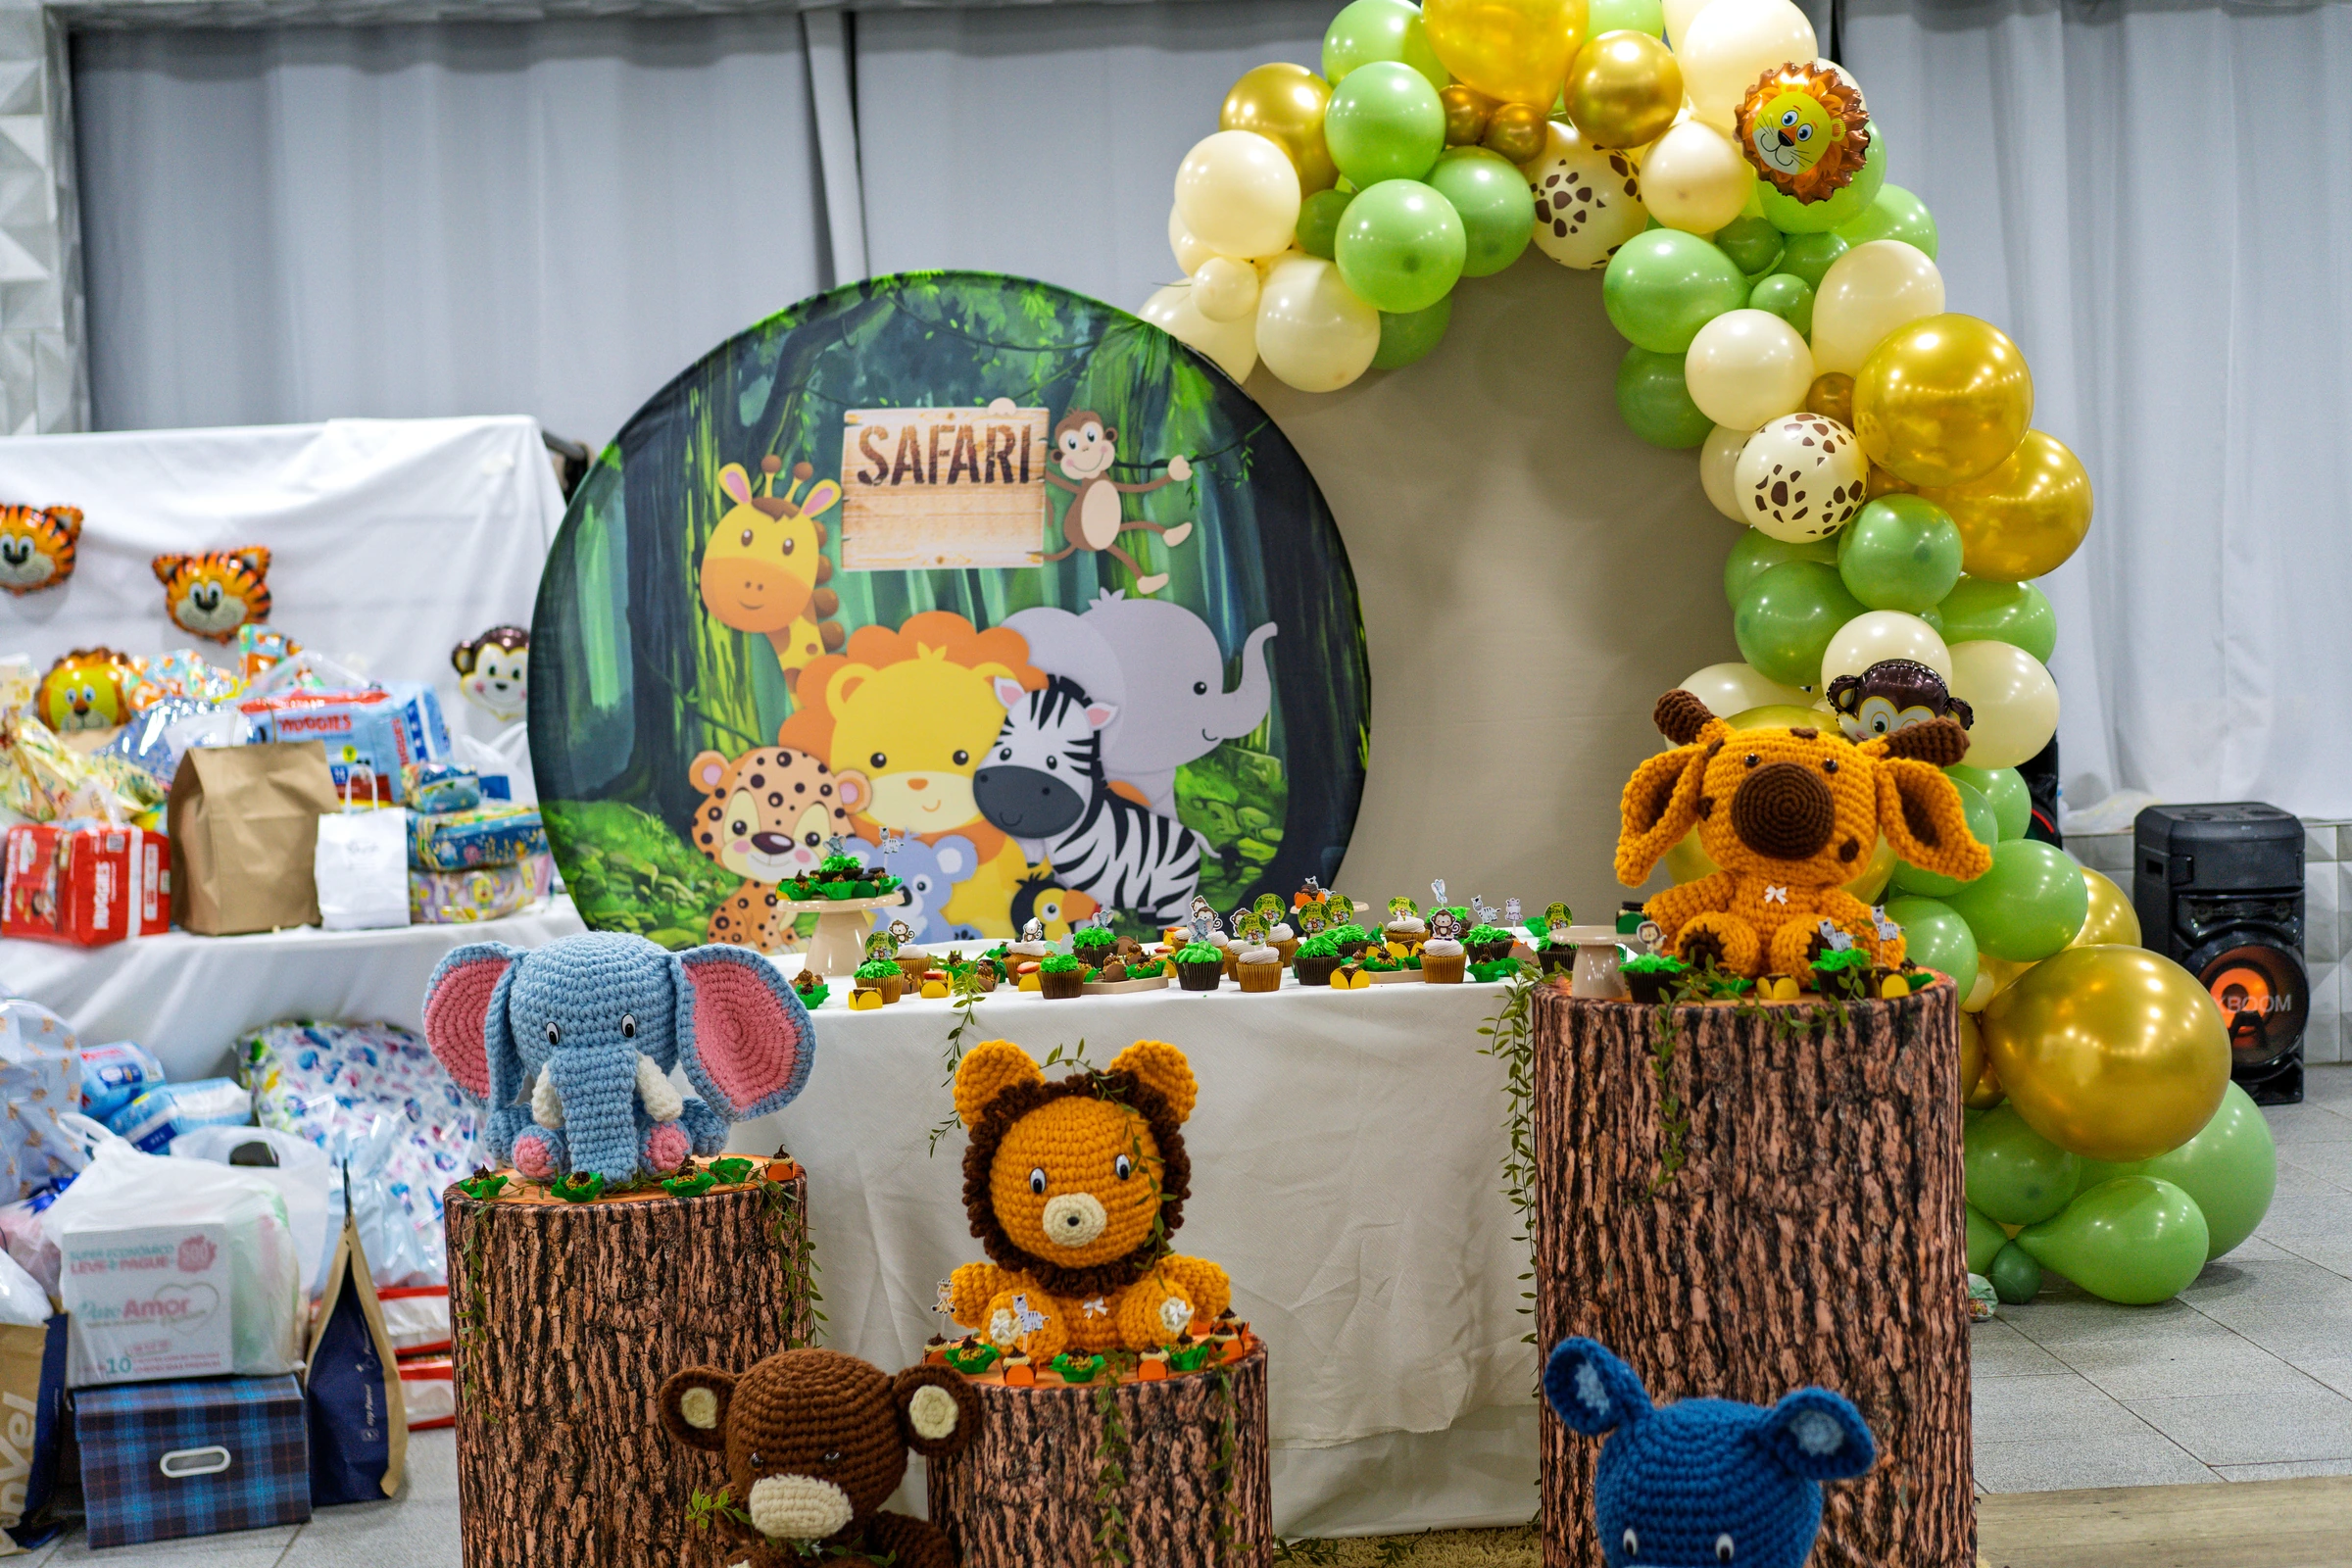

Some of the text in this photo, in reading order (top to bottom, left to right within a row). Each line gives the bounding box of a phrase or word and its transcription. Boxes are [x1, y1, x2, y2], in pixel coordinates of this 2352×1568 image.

[858, 423, 1032, 486] SAFARI
[122, 1298, 190, 1318] Amor
[106, 1356, 132, 1374] 10
